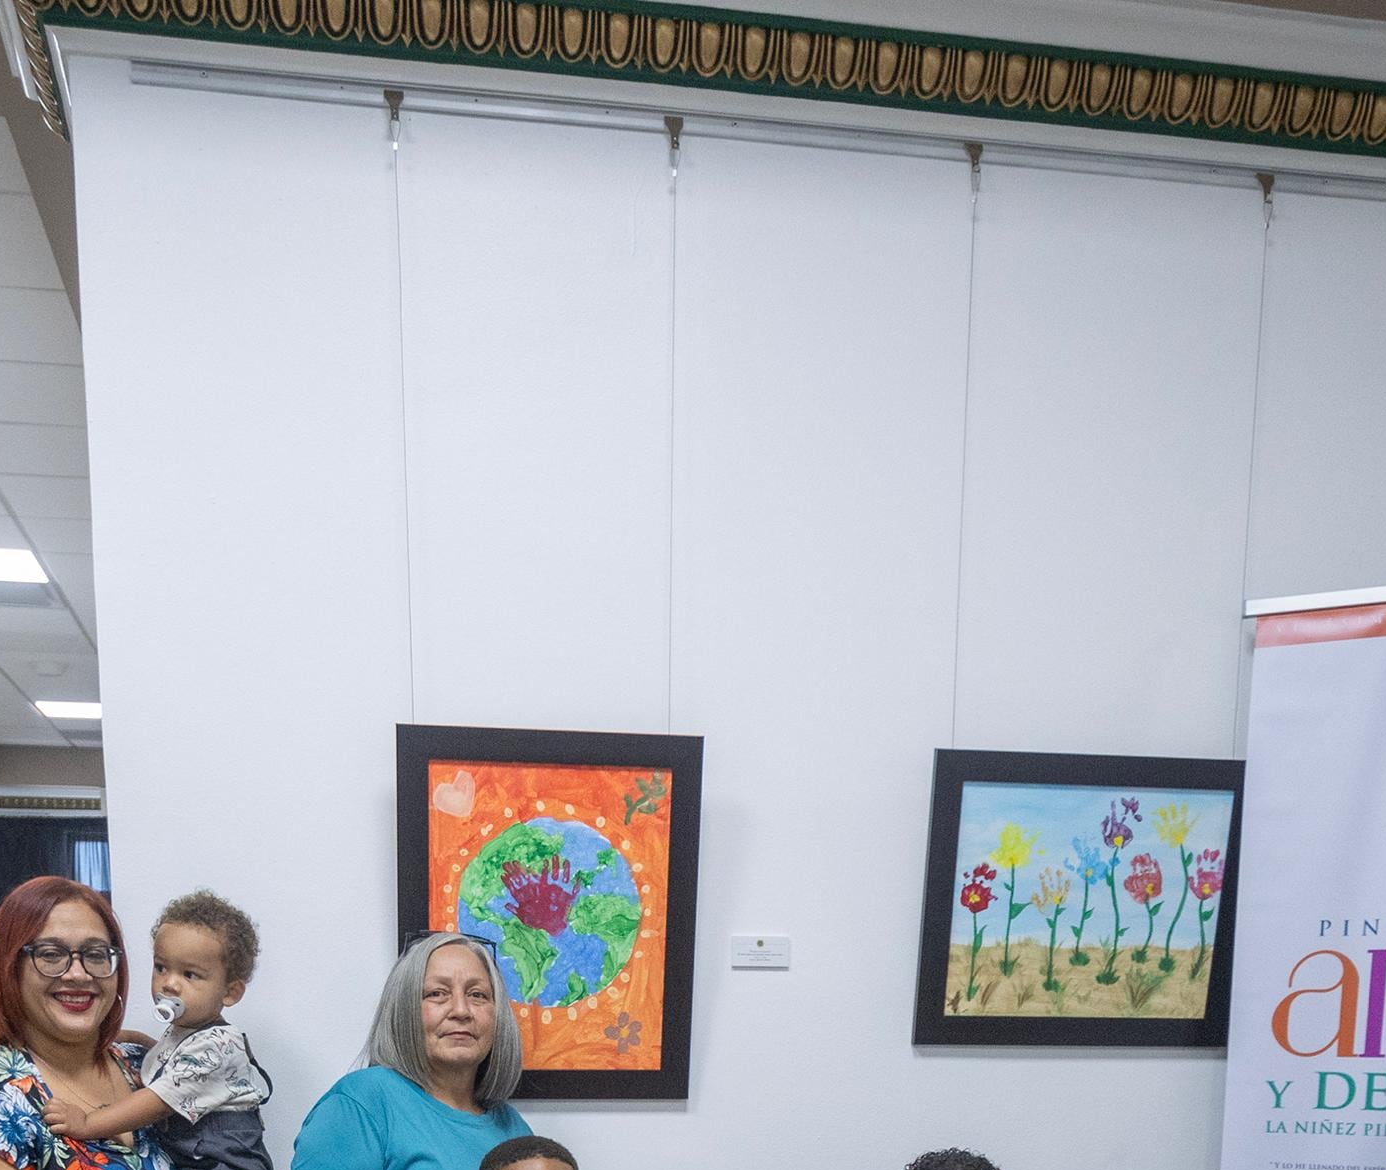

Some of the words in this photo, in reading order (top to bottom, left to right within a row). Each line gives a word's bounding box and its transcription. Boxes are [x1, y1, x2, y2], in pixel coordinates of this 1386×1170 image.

[1265, 1080, 1294, 1109] Y
[1265, 1120, 1288, 1134] LA
[1294, 1119, 1357, 1136] NIÑEZ
